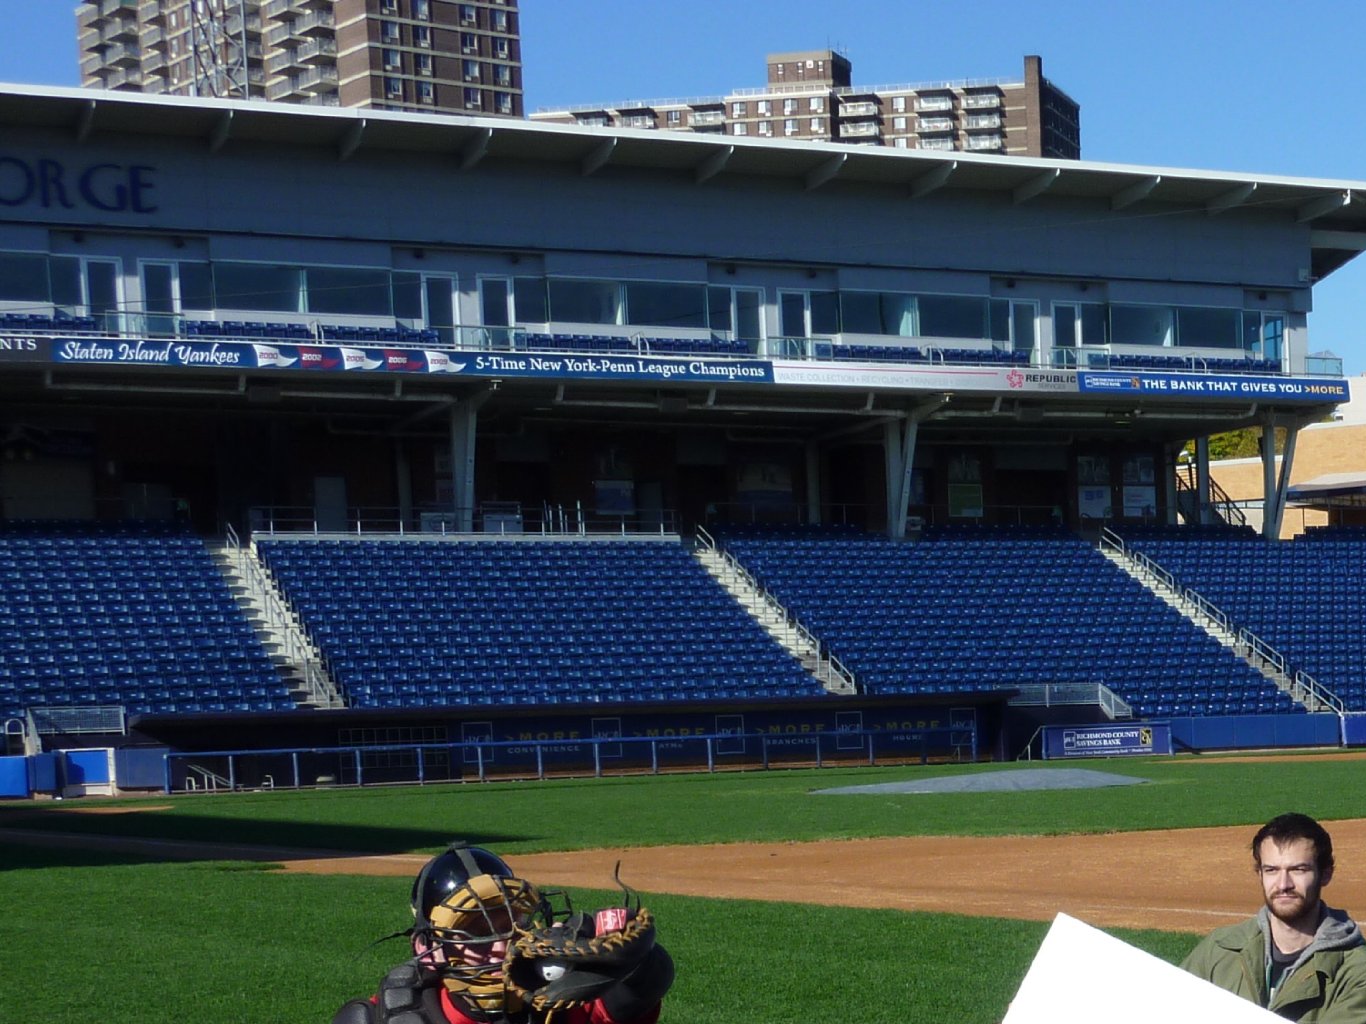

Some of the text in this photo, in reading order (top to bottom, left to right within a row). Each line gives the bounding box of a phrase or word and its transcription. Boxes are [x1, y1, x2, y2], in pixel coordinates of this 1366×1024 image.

[60, 340, 240, 364] Staten Island Yankees
[302, 353, 322, 361] 2002
[475, 356, 765, 380] 5-Time New York-Penn League Champions
[1025, 374, 1077, 384] REPUBLIC
[1142, 379, 1167, 389] THE
[1170, 380, 1205, 391] BANK
[1206, 381, 1239, 392] THAT
[1241, 382, 1277, 393] GIVES
[1278, 383, 1302, 394] YOU
[1076, 731, 1112, 740] RICHMOND
[507, 745, 581, 754] CONVNIENCE
